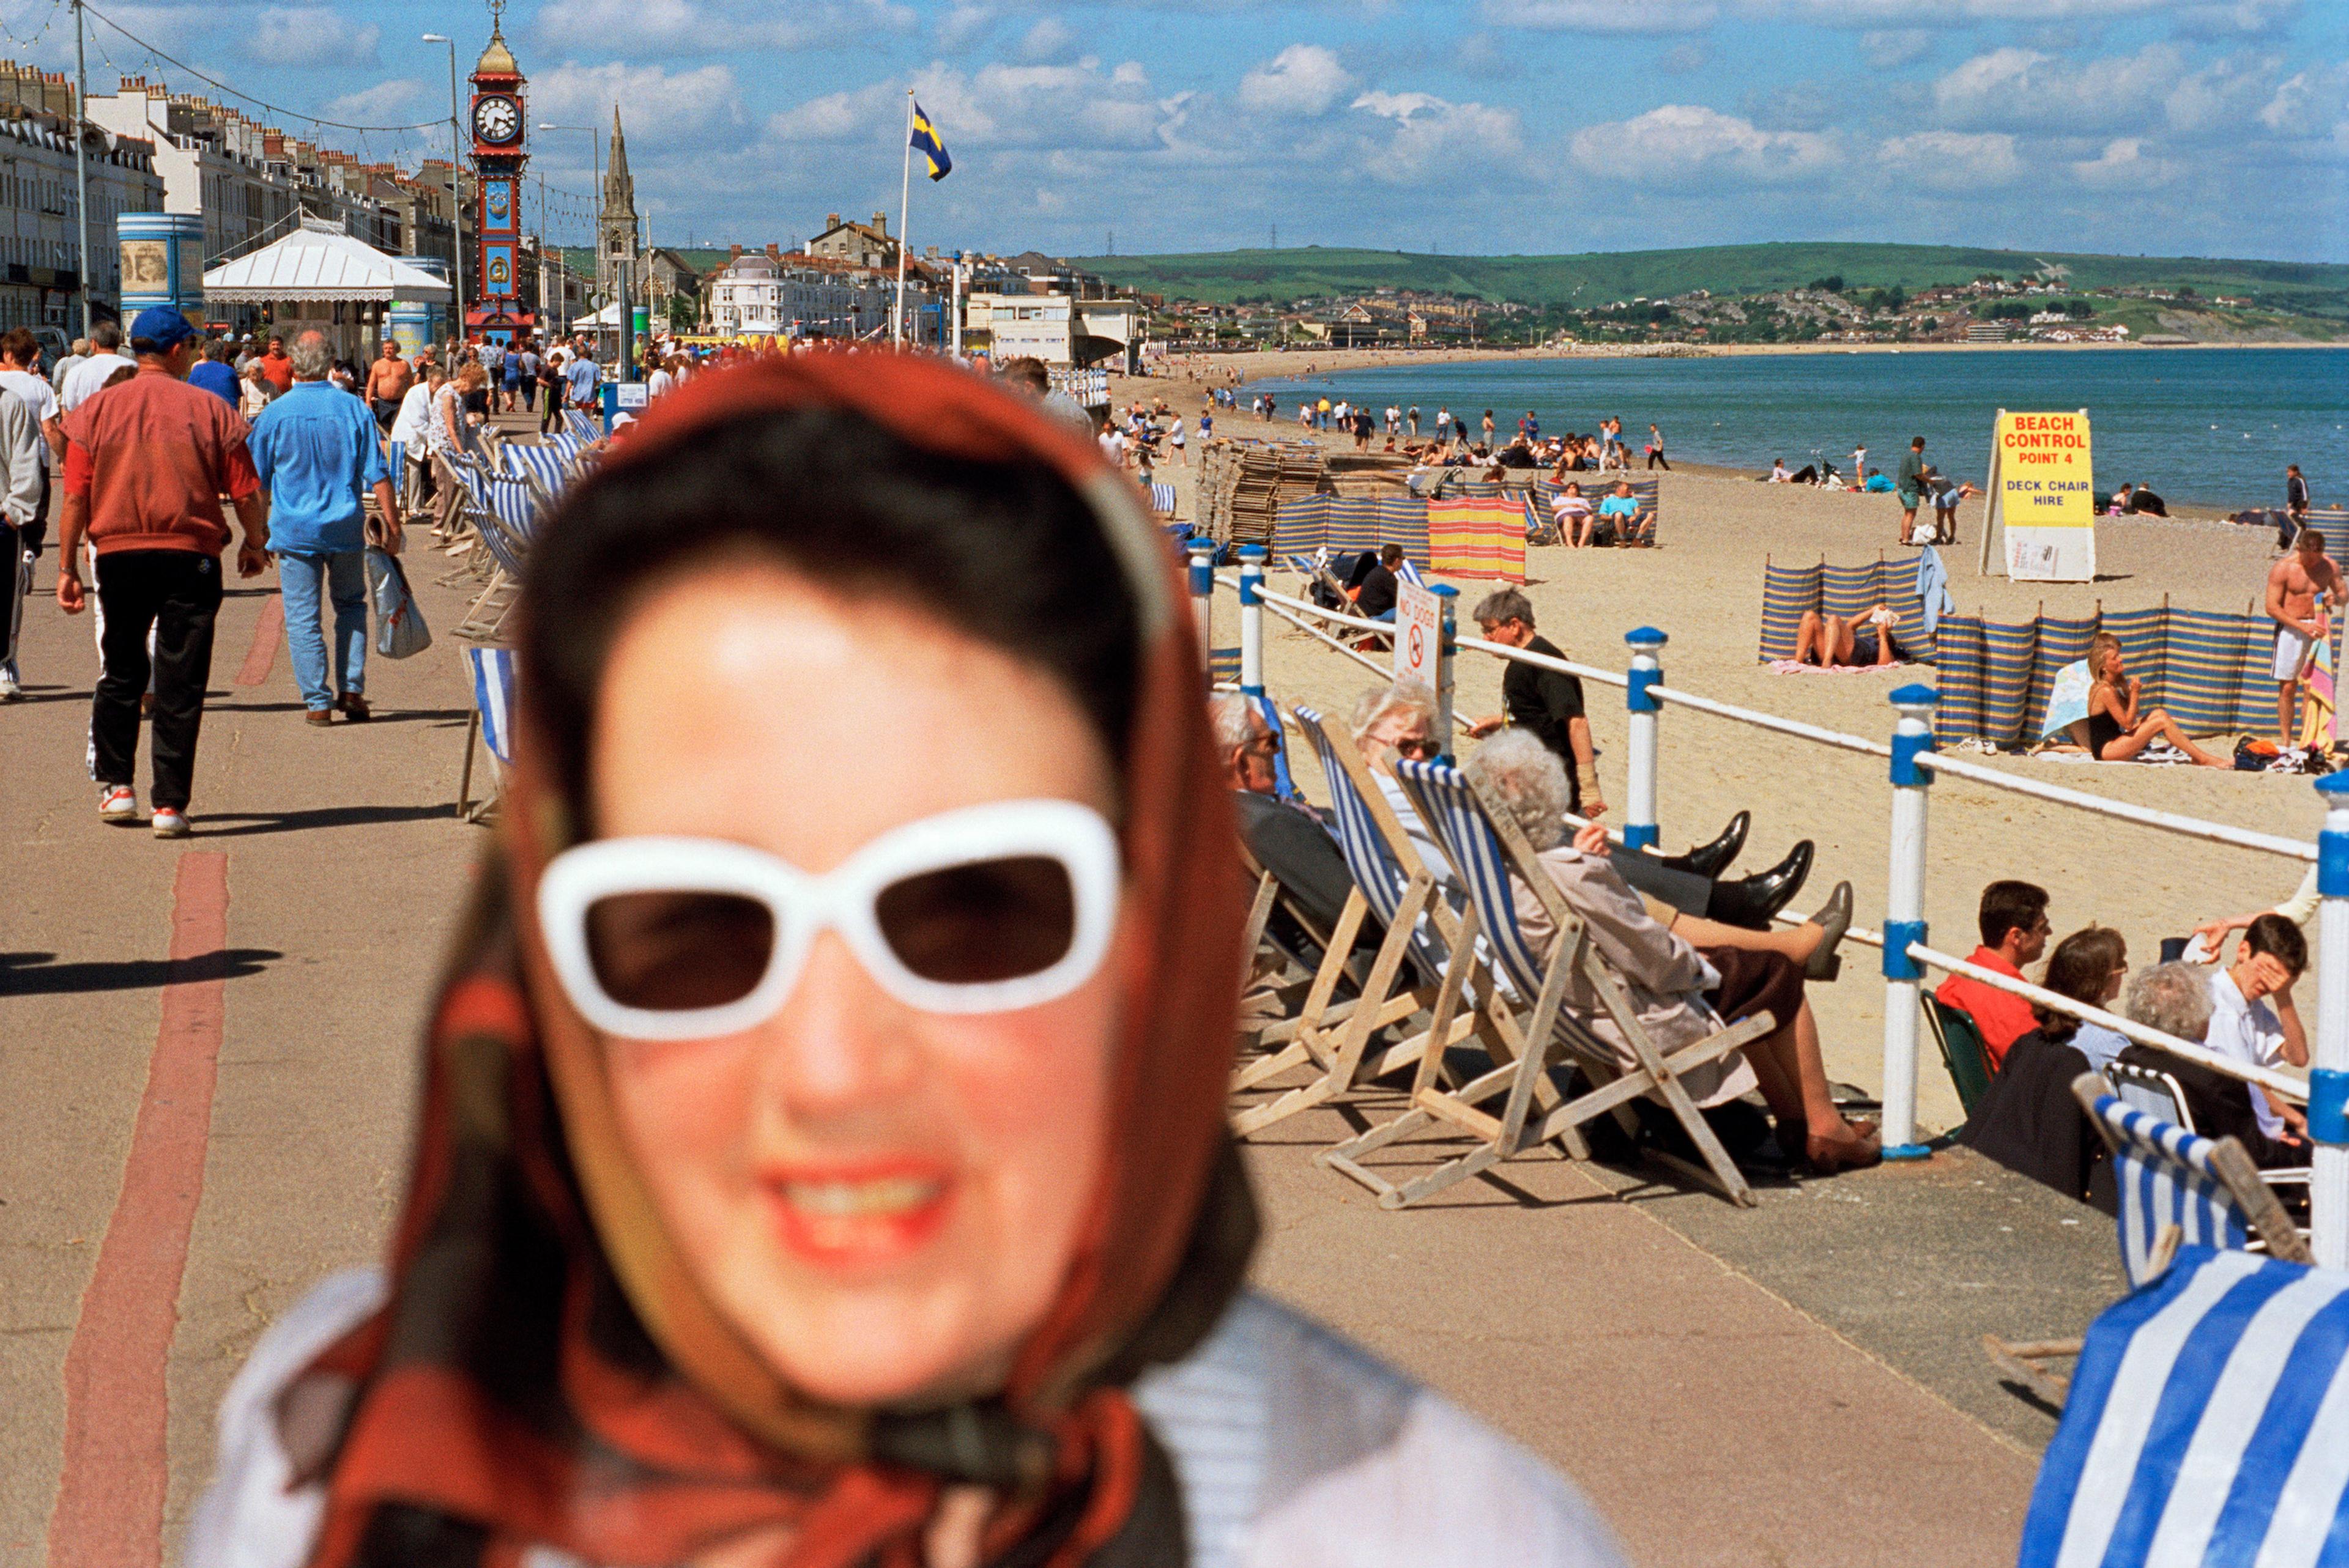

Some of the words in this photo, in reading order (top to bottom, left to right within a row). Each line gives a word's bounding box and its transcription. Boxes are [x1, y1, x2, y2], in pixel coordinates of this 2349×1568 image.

[2016, 417, 2074, 431] BEACH
[2005, 434, 2086, 448] CONTROL
[2019, 453, 2058, 464] POINT
[2065, 453, 2073, 464] 4
[2007, 481, 2042, 490] DECK
[2049, 481, 2089, 491] CHAIR
[2034, 496, 2064, 506] HIRE
[1400, 597, 1410, 616] NO
[1414, 604, 1434, 629] DOGS
